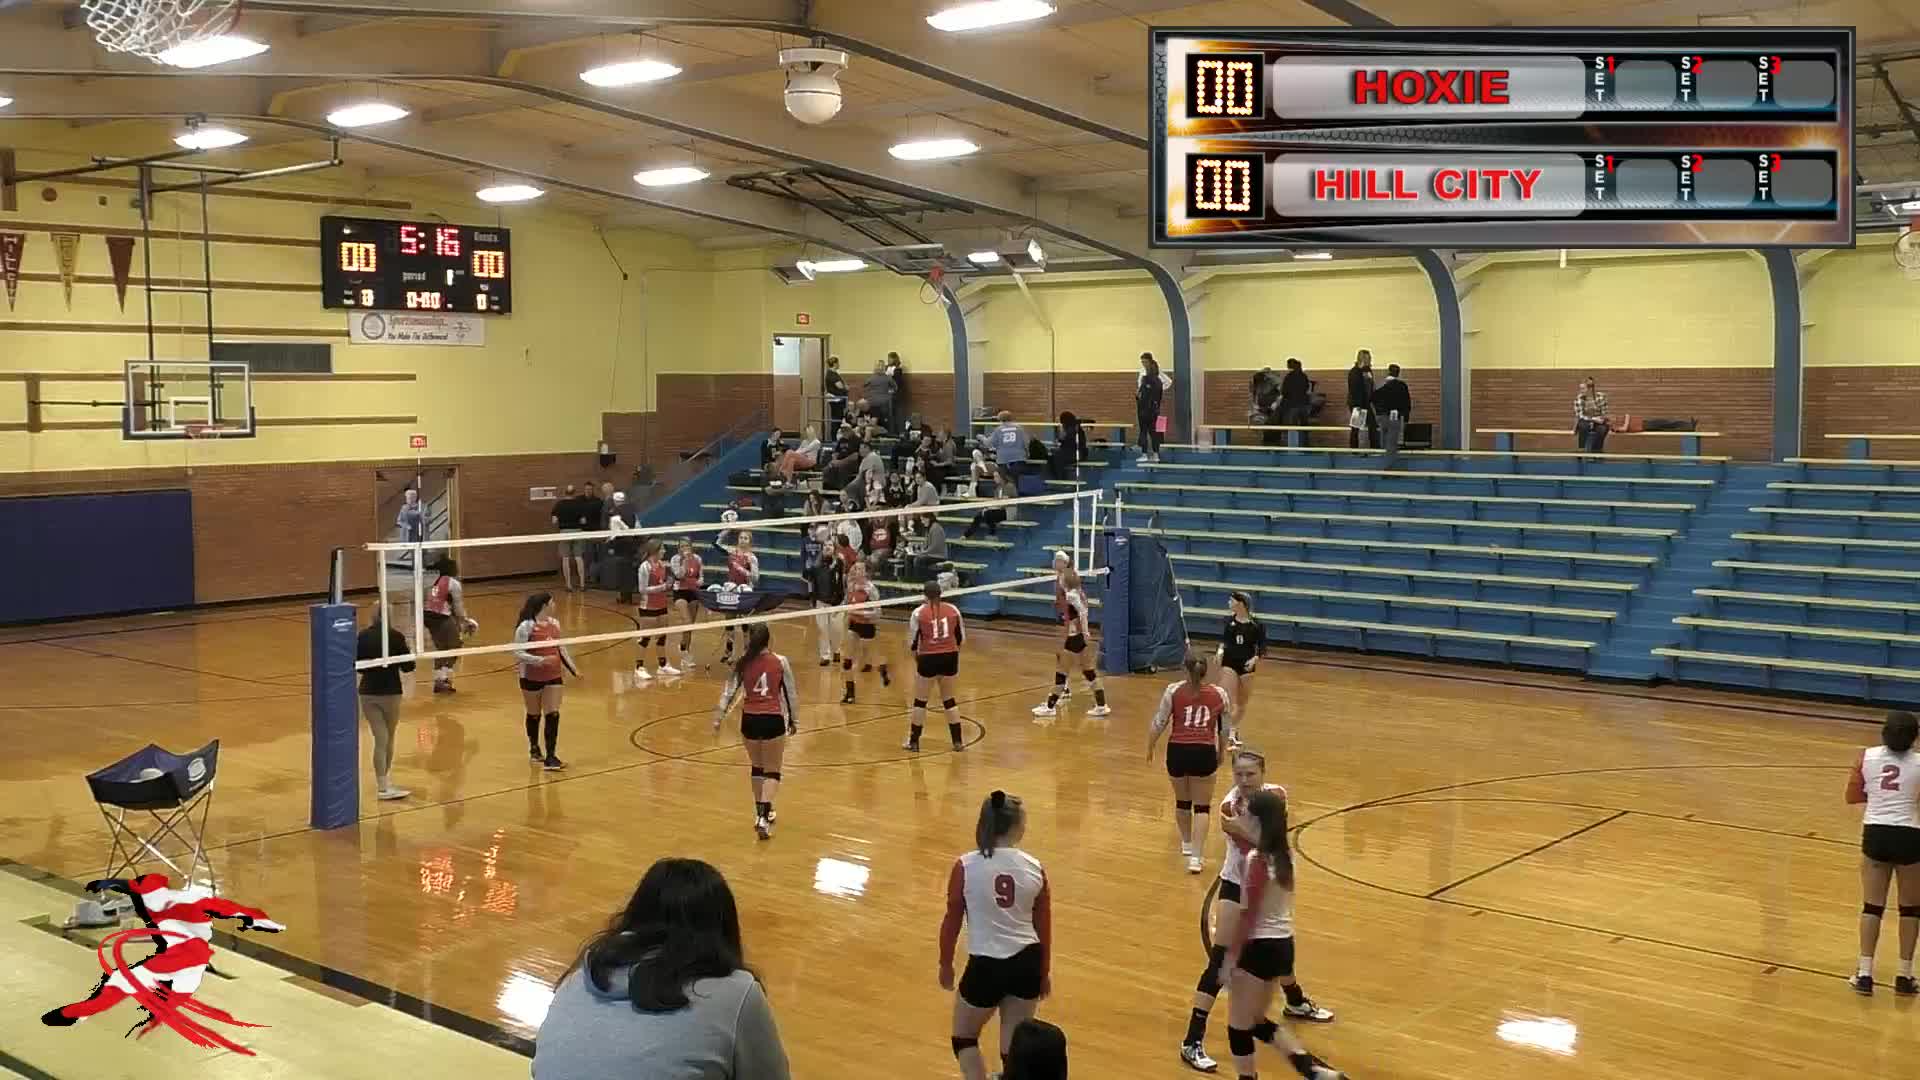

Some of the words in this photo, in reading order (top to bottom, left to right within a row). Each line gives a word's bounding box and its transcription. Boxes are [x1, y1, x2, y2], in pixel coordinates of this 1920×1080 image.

[400, 226, 460, 257] 5:16
[340, 241, 377, 272] 00
[472, 250, 505, 279] 00
[930, 616, 950, 639] 11
[752, 671, 769, 696] 4
[1183, 704, 1211, 728] 10
[1881, 764, 1900, 792] 2
[994, 874, 1016, 909] 9
